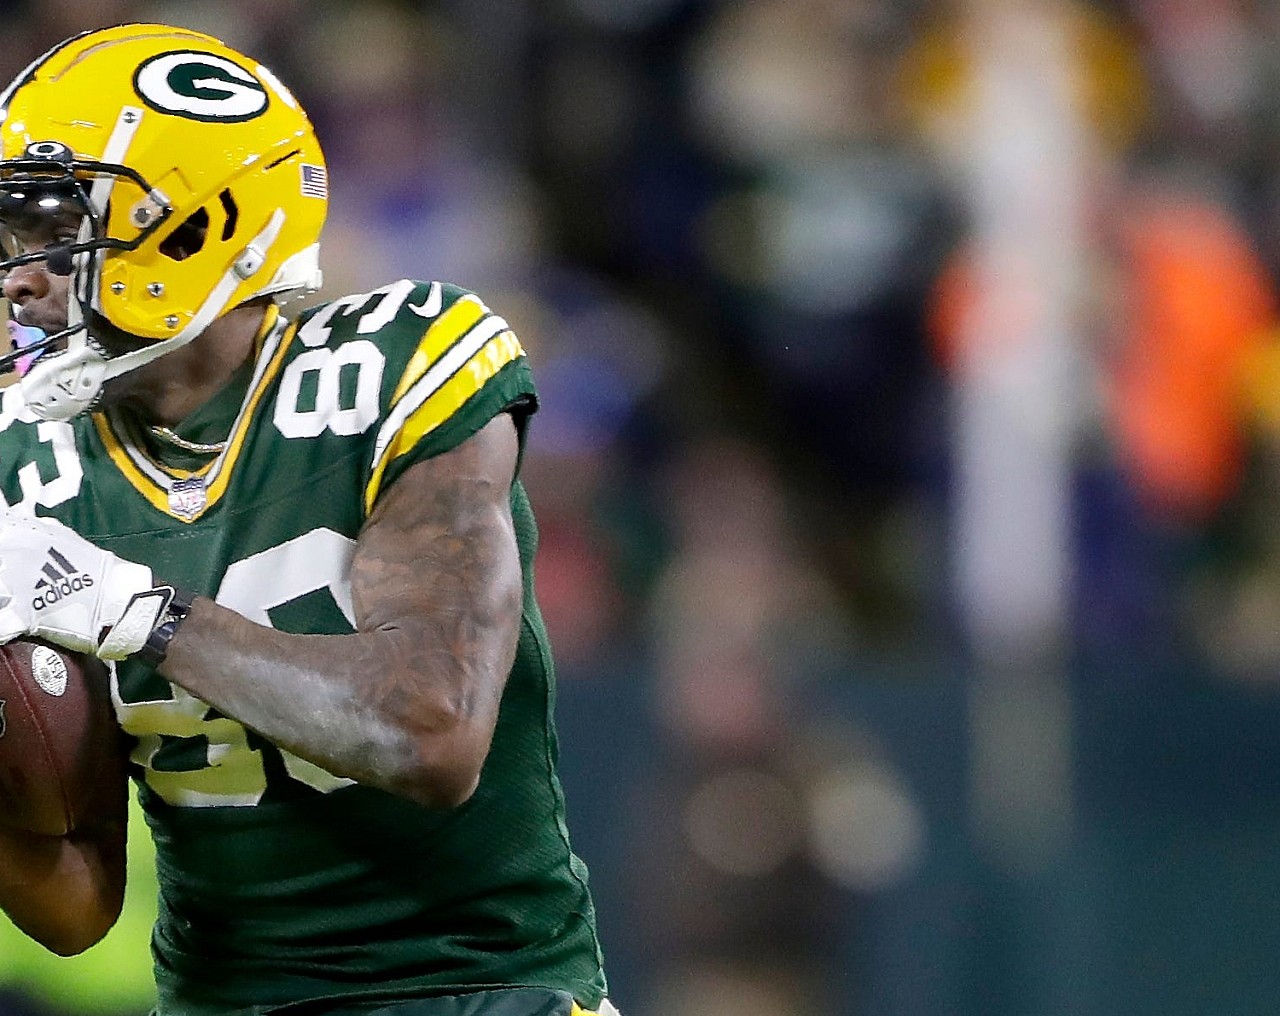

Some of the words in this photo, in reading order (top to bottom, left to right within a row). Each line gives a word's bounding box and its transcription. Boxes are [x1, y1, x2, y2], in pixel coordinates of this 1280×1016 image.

[133, 49, 269, 123] G
[273, 279, 417, 439] 83
[33, 573, 94, 611] adidas
